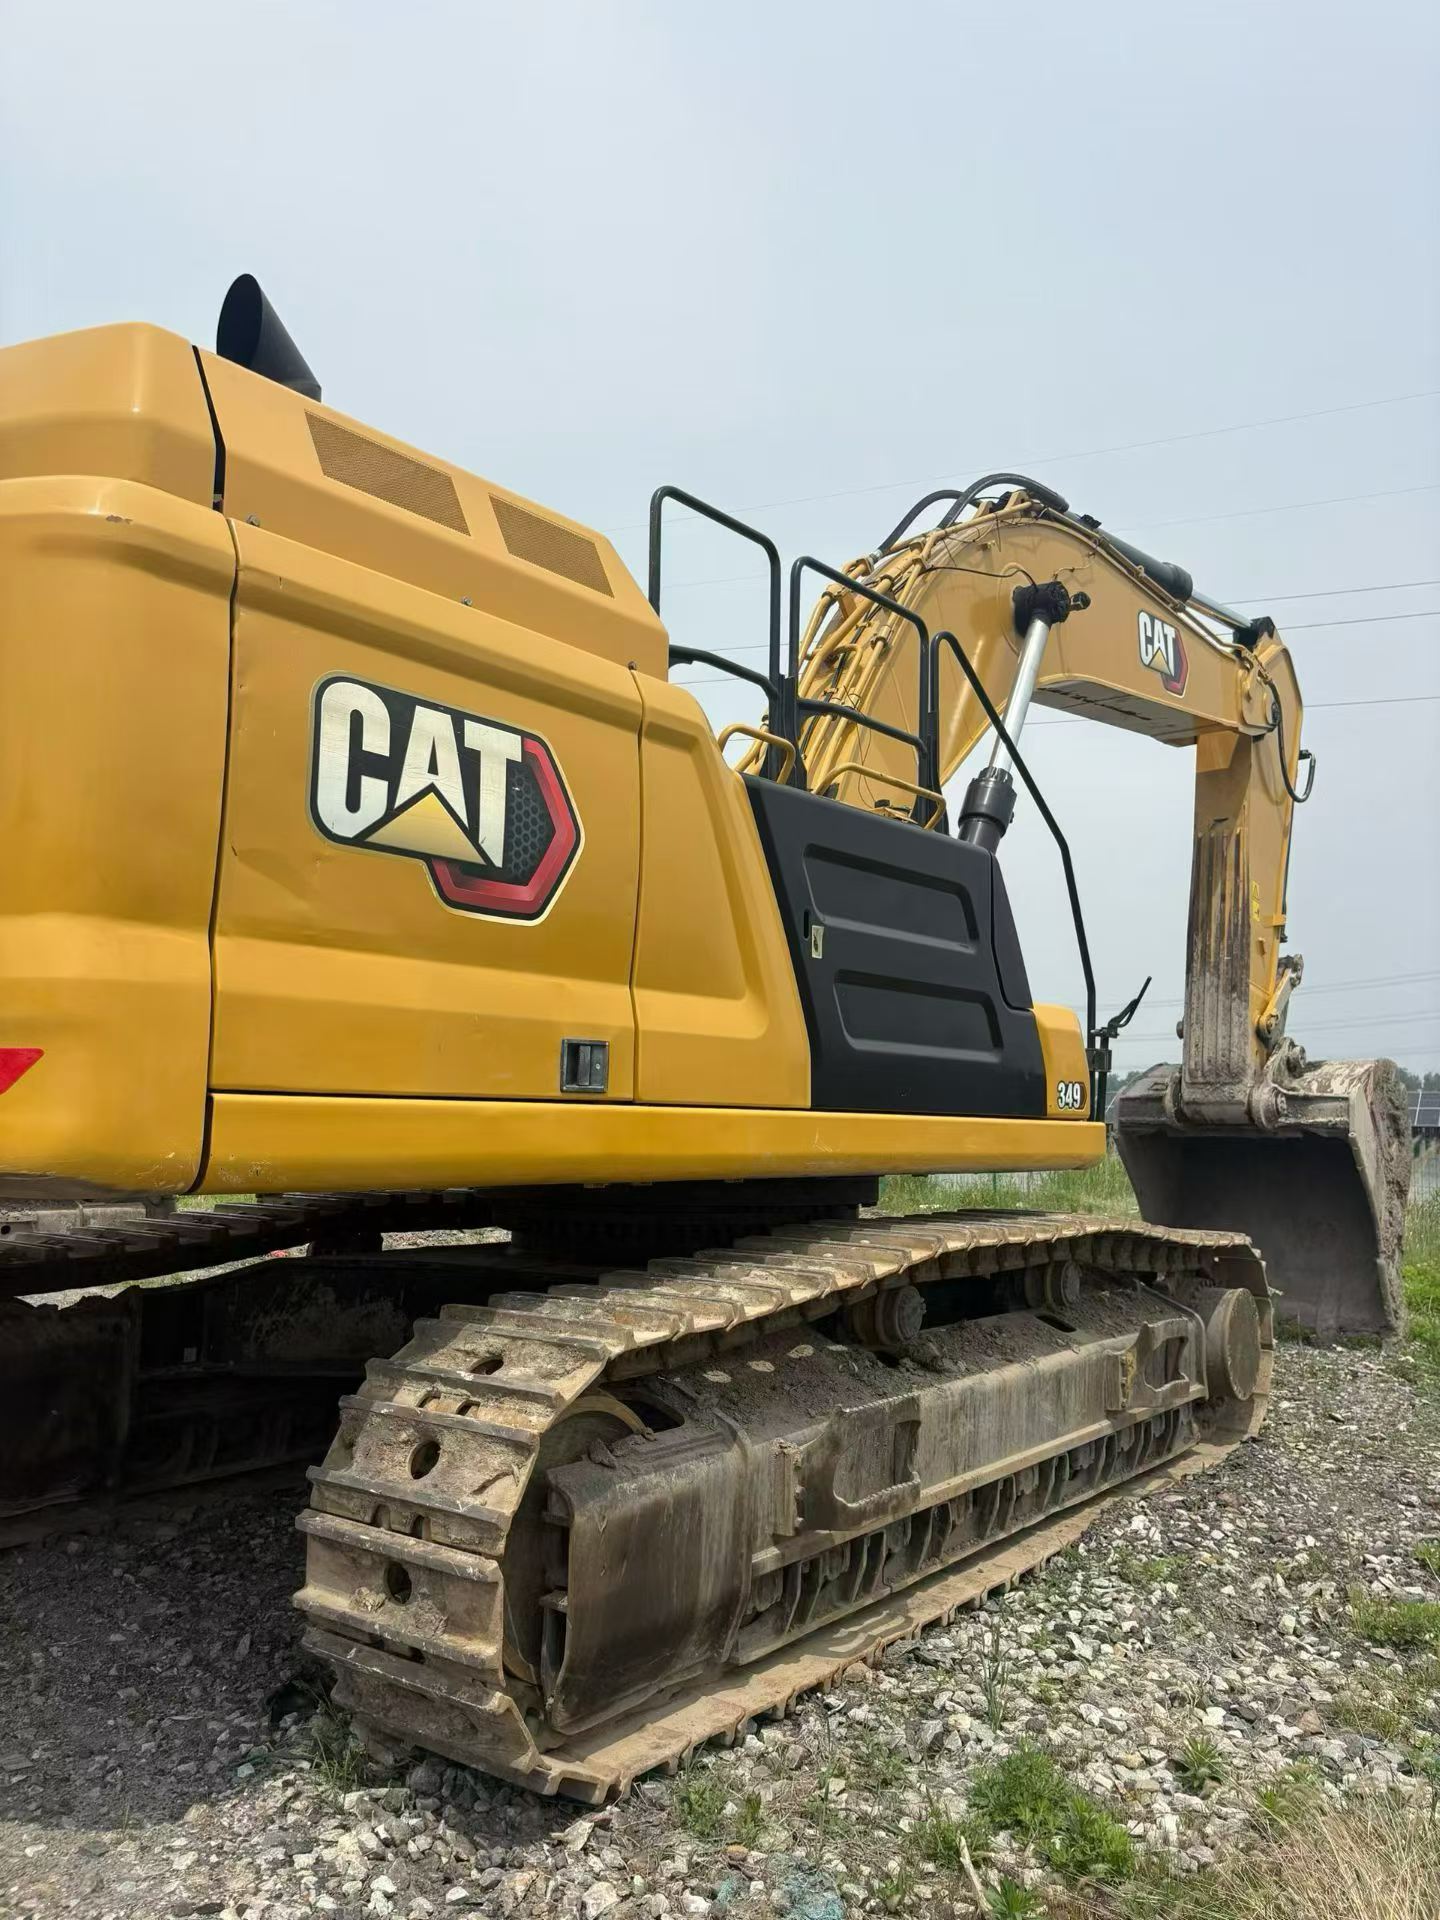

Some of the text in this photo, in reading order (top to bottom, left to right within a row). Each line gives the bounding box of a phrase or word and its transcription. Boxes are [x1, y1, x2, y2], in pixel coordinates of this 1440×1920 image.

[1138, 611, 1175, 677] CAT
[317, 681, 522, 868] CAT
[1058, 1082, 1080, 1109] 349
